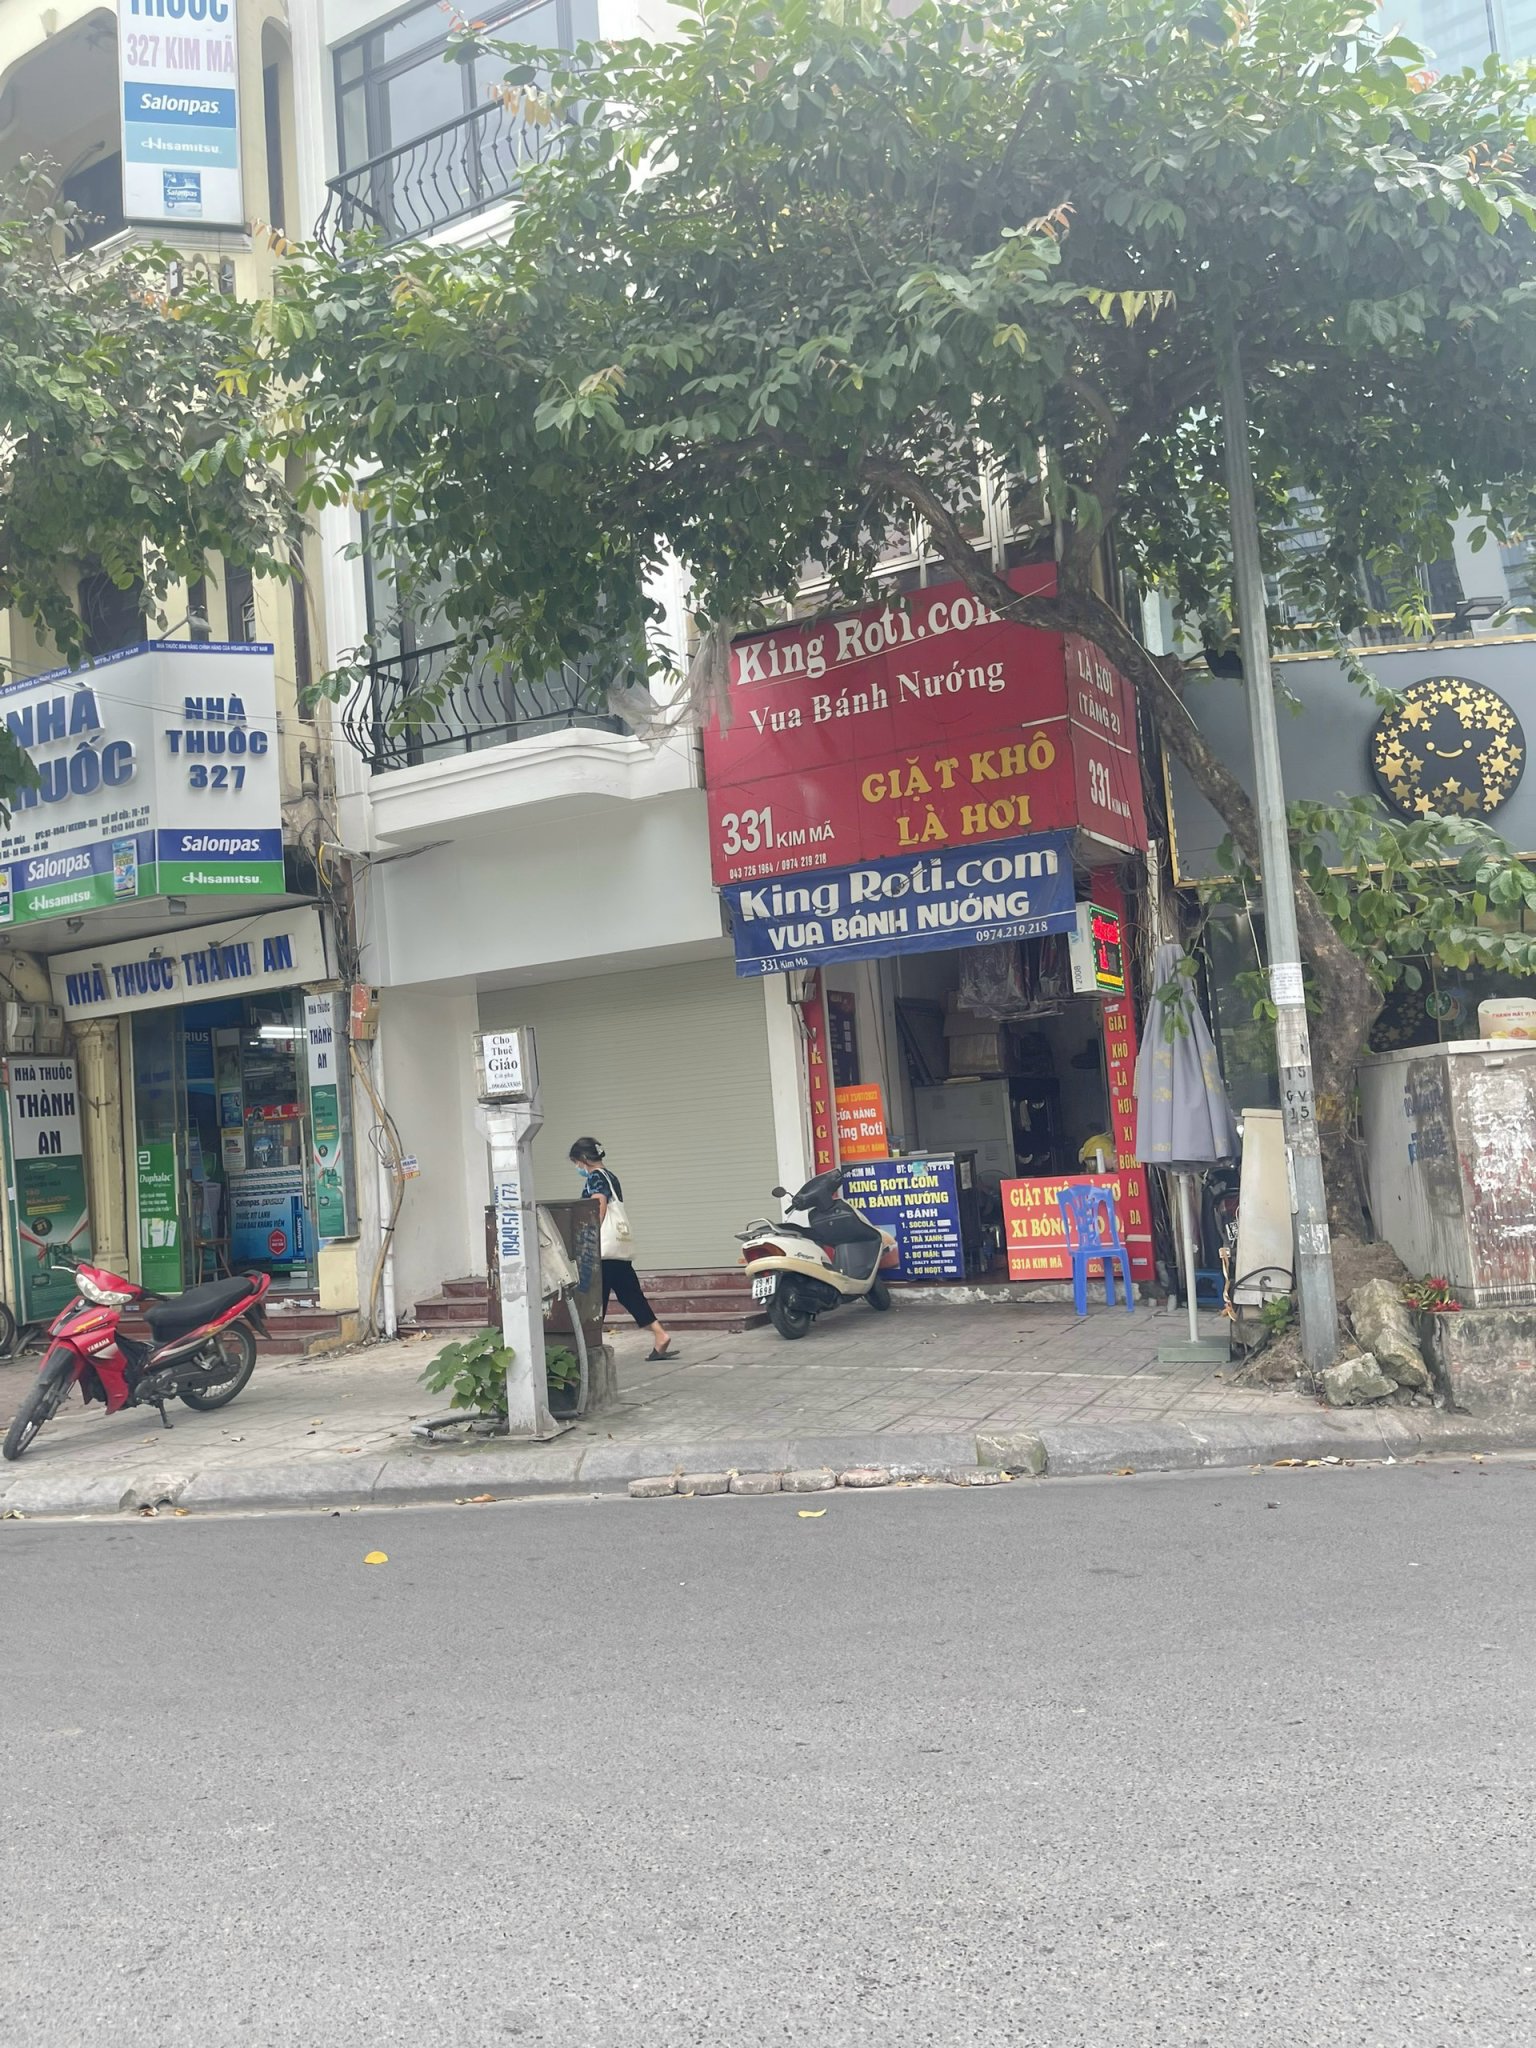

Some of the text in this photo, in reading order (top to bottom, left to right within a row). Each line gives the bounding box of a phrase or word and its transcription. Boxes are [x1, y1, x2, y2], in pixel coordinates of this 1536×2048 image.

[127, 33, 159, 67] 327
[165, 36, 200, 70] KIM
[140, 94, 219, 115] Salonpas
[141, 137, 220, 153] Hisamitsu
[735, 634, 827, 687] King
[1078, 649, 1093, 685] LÀ
[185, 693, 246, 720] NHÀ
[749, 660, 1006, 735] Vua Bánh Nướng
[6, 682, 101, 749] NHÀ
[1110, 714, 1121, 736] 2)
[166, 725, 268, 754] THUỐC
[190, 765, 245, 789] 327
[862, 731, 1056, 803] GIẶT KHÔ
[1089, 758, 1112, 812] 331
[1111, 798, 1122, 815] KIM
[721, 806, 836, 855] 331 KIM MÃ
[896, 795, 1033, 846] LÀ HƠI
[181, 836, 260, 854] Salonpas
[28, 853, 91, 882] Salonpas
[729, 867, 743, 880] 043
[744, 865, 757, 877] 726
[781, 858, 798, 871] 0974
[800, 855, 813, 867] 219
[815, 853, 827, 865] 218
[182, 872, 260, 884] Hisamitsu
[740, 849, 1059, 922] King Roti.com
[29, 890, 91, 911] Hisamitsu
[768, 922, 824, 951] VUA
[831, 908, 909, 943] BÁNH
[976, 921, 1049, 943] 0974.219.218
[66, 934, 293, 1006] NHÀ THUỐC THÀNH AN
[760, 959, 780, 972] 331
[780, 959, 796, 970] Kim
[310, 1026, 333, 1045] THÀNH
[492, 1036, 510, 1045] Cho
[1112, 1040, 1129, 1058] KHÔ
[15, 1061, 73, 1081] NHÀ THUỐC
[318, 1053, 327, 1069] AN
[488, 1057, 518, 1071] Giáo
[1117, 1067, 1128, 1086] LÀ
[16, 1089, 75, 1118] THÀNH
[852, 1107, 877, 1119] HÀNG
[838, 1121, 883, 1141] ing Roti
[1123, 1127, 1133, 1141] XI
[38, 1131, 62, 1155] AN
[140, 1172, 173, 1184] Duphalac
[849, 1175, 939, 1193] KING ROTI.COM
[1128, 1178, 1139, 1197] ÁO
[869, 1193, 902, 1208] BÁNH
[1010, 1183, 1041, 1211] GIẶT
[906, 1208, 938, 1218] BÁNH
[1130, 1209, 1142, 1225] DA
[909, 1220, 936, 1228] SOCOLA:
[1011, 1219, 1028, 1238] XI
[910, 1235, 923, 1243] TRÀ
[1012, 1257, 1031, 1270] 331A
[1033, 1258, 1048, 1269] KIM
[87, 1337, 111, 1352] YAMAHA
